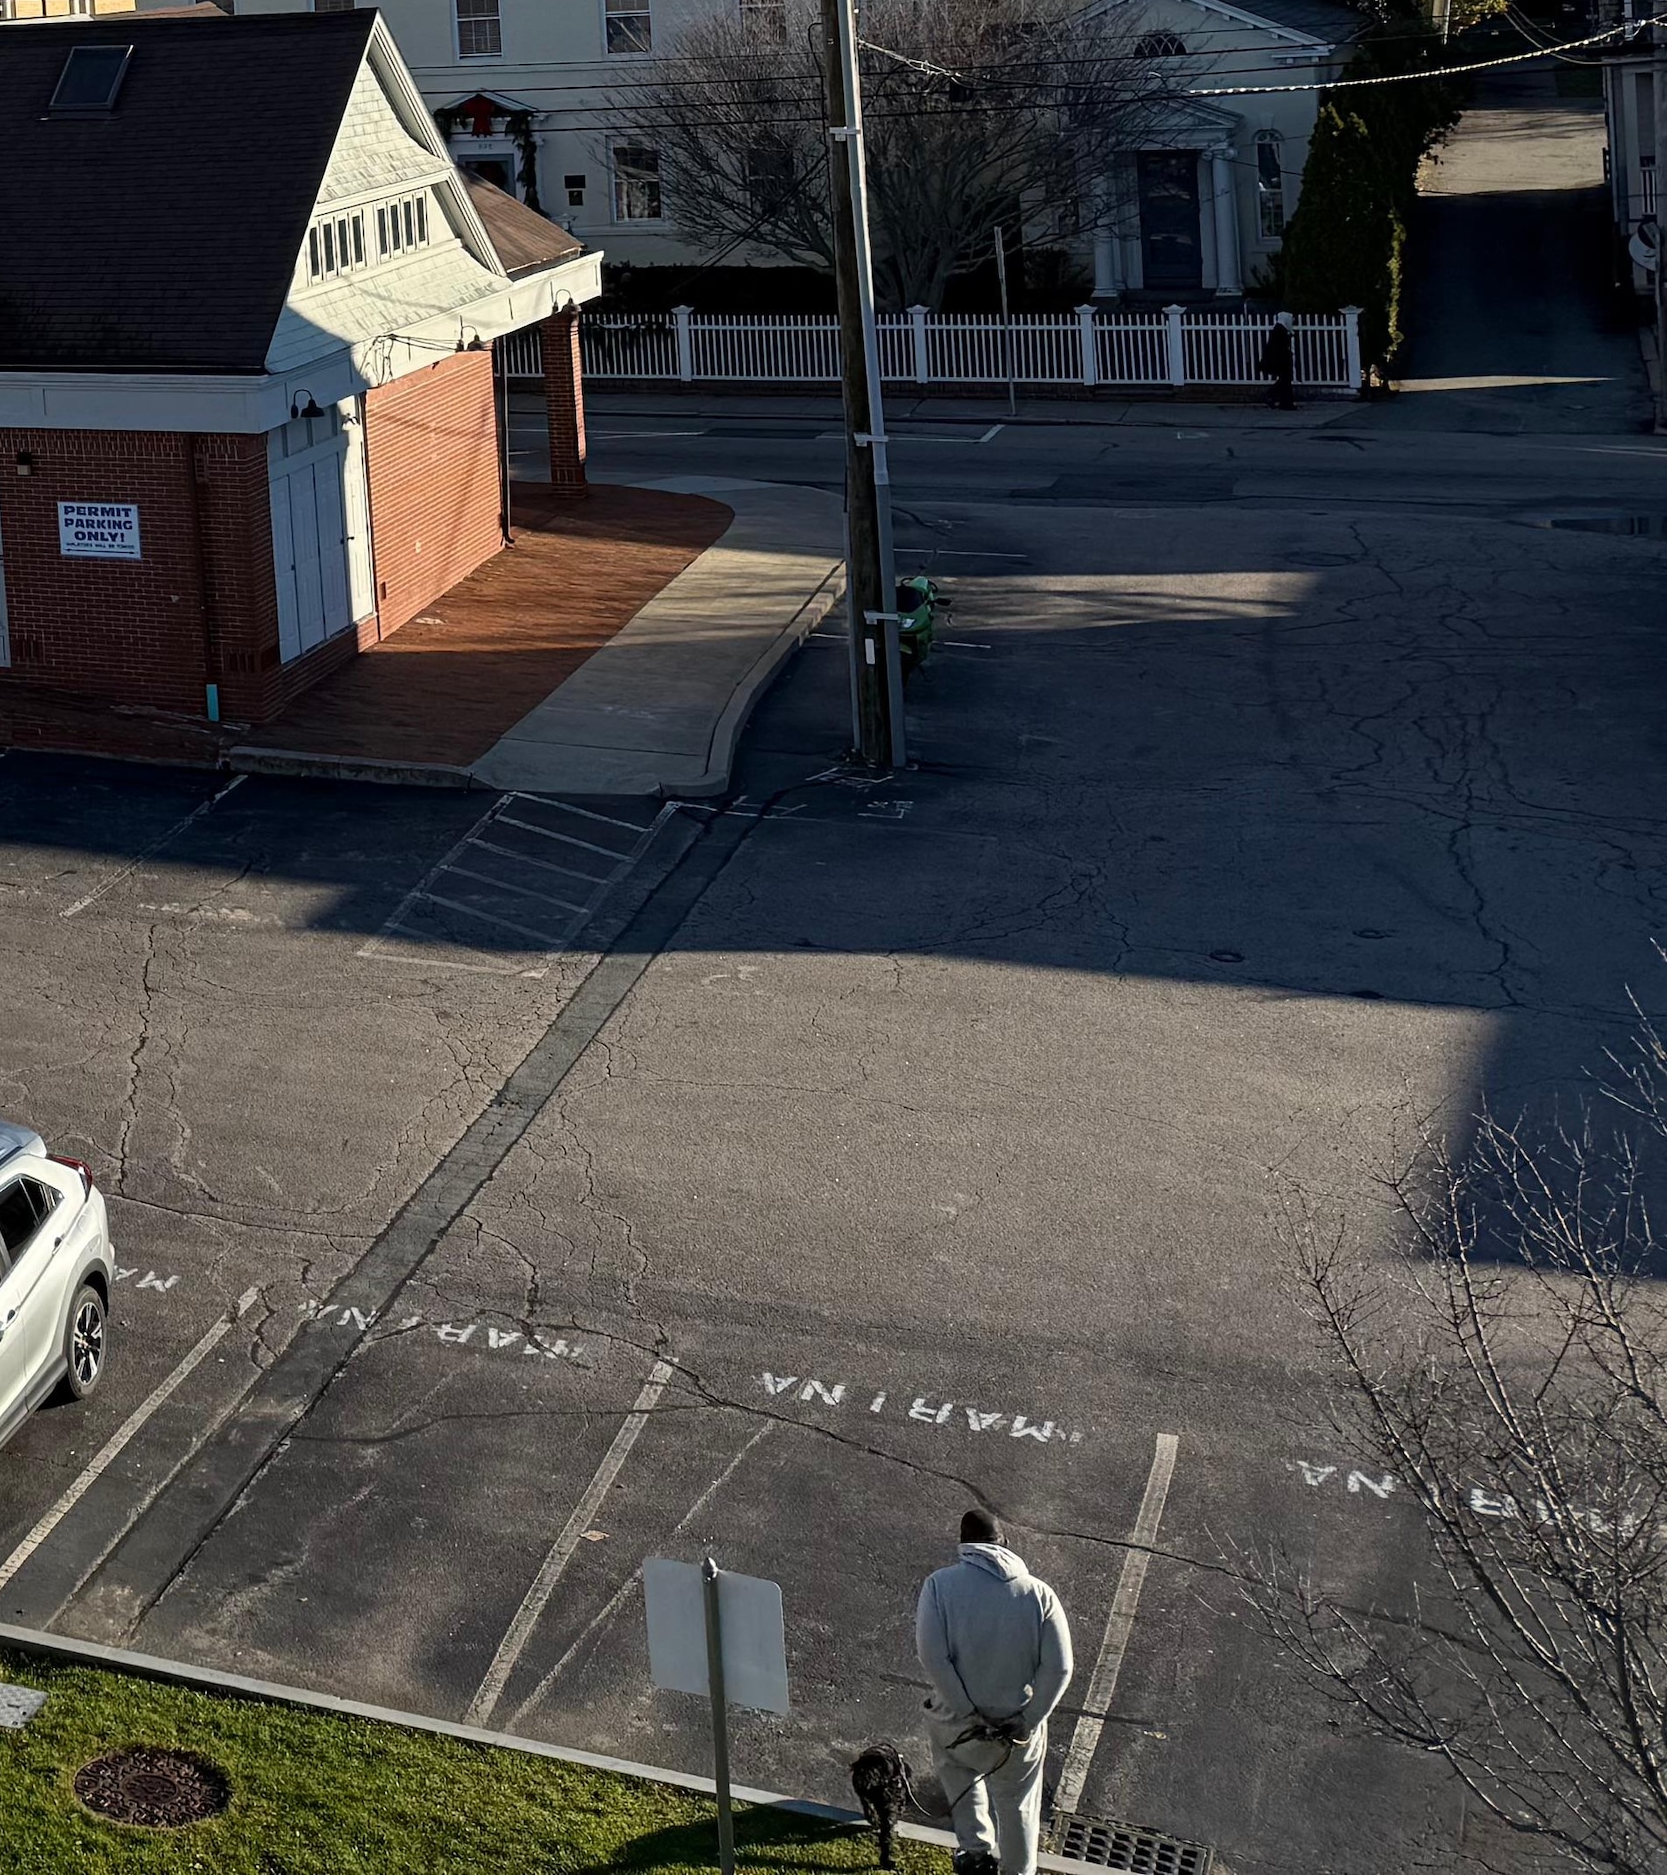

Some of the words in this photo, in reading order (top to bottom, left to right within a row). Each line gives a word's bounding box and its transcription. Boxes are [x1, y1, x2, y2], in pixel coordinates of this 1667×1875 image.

[64, 505, 132, 517] PERMIT
[64, 518, 133, 530] PARKING
[74, 531, 125, 543] ONLY!
[760, 1371, 1067, 1444] MARINA
